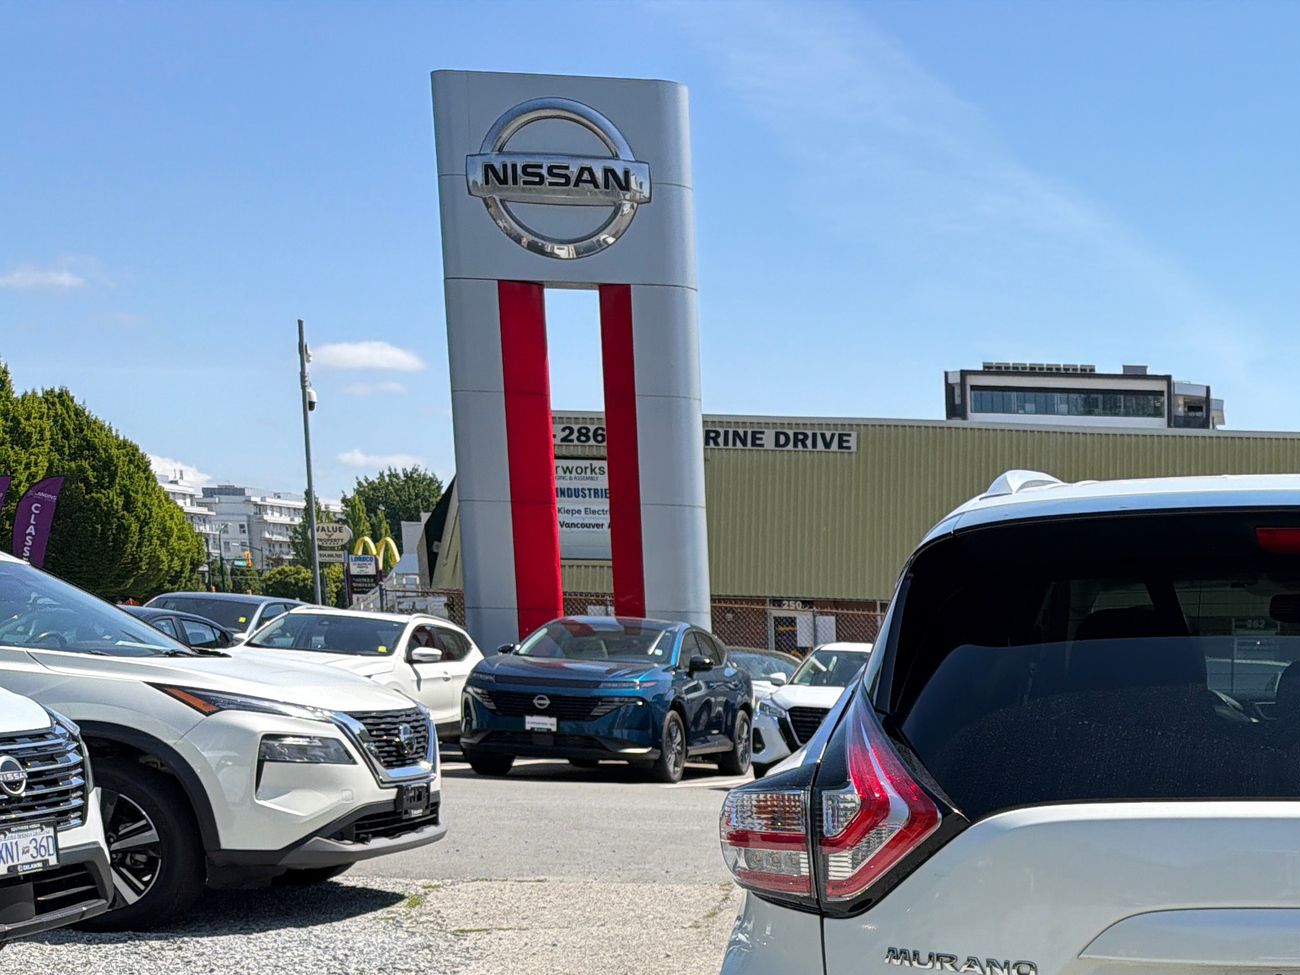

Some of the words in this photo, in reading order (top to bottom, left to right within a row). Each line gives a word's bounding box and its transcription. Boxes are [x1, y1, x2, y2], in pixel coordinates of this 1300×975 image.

[483, 162, 631, 192] NISSAN
[774, 431, 852, 450] DRIVE
[22, 503, 41, 561] CLASS
[559, 521, 605, 530] Vancouver
[782, 600, 802, 610] 250
[29, 835, 55, 859] 36D
